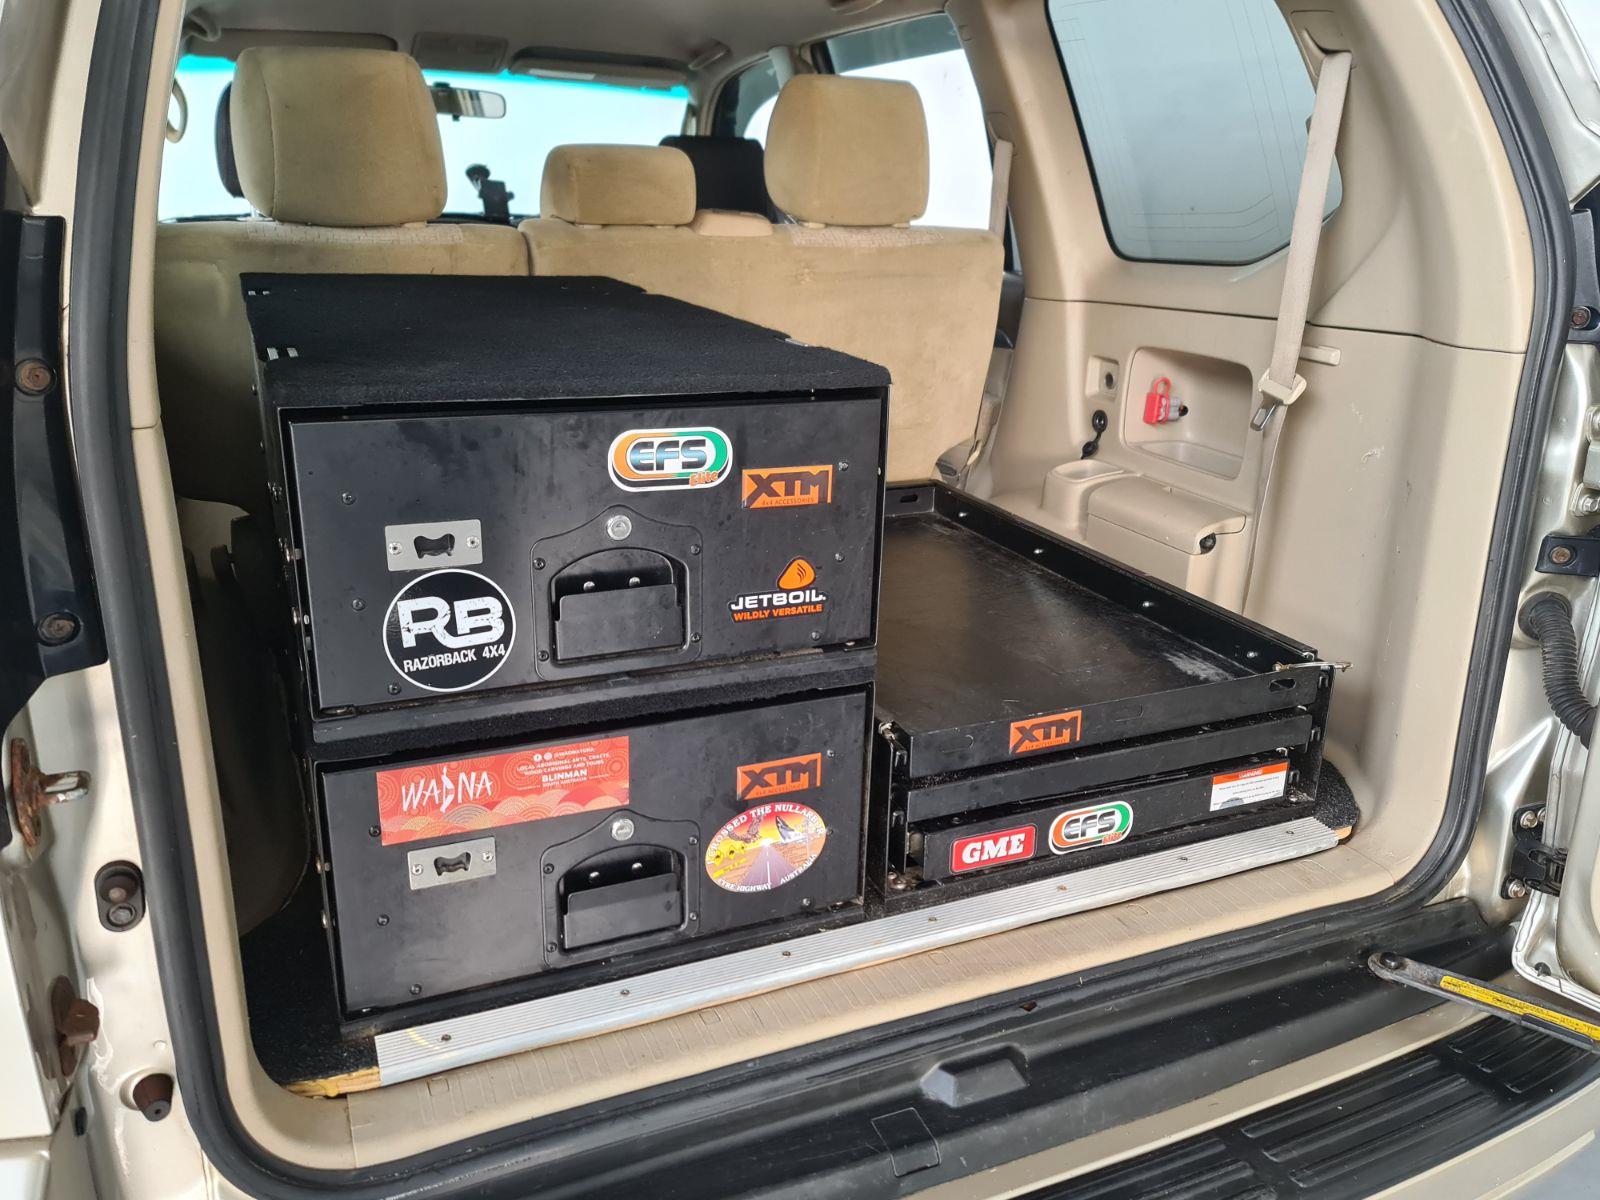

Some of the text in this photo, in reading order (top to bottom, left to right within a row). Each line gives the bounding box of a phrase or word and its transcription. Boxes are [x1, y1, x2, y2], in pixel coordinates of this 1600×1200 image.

[630, 438, 708, 472] EFS
[689, 470, 719, 488] Elite
[743, 470, 829, 508] XTM
[731, 589, 822, 610] JETBOIL
[733, 603, 823, 621] WILDLY VERSATILE
[397, 596, 505, 649] RB
[403, 643, 506, 673] RAZORBACK 4X4
[1011, 715, 1079, 754] XTM
[541, 768, 588, 783] BLINMAN
[741, 758, 818, 799] XTM
[750, 804, 773, 818] THE
[1063, 810, 1116, 840] EFS
[962, 833, 1026, 864] GME
[736, 881, 773, 892] HIGHWAY
[780, 853, 818, 885] AUSTRALIA
